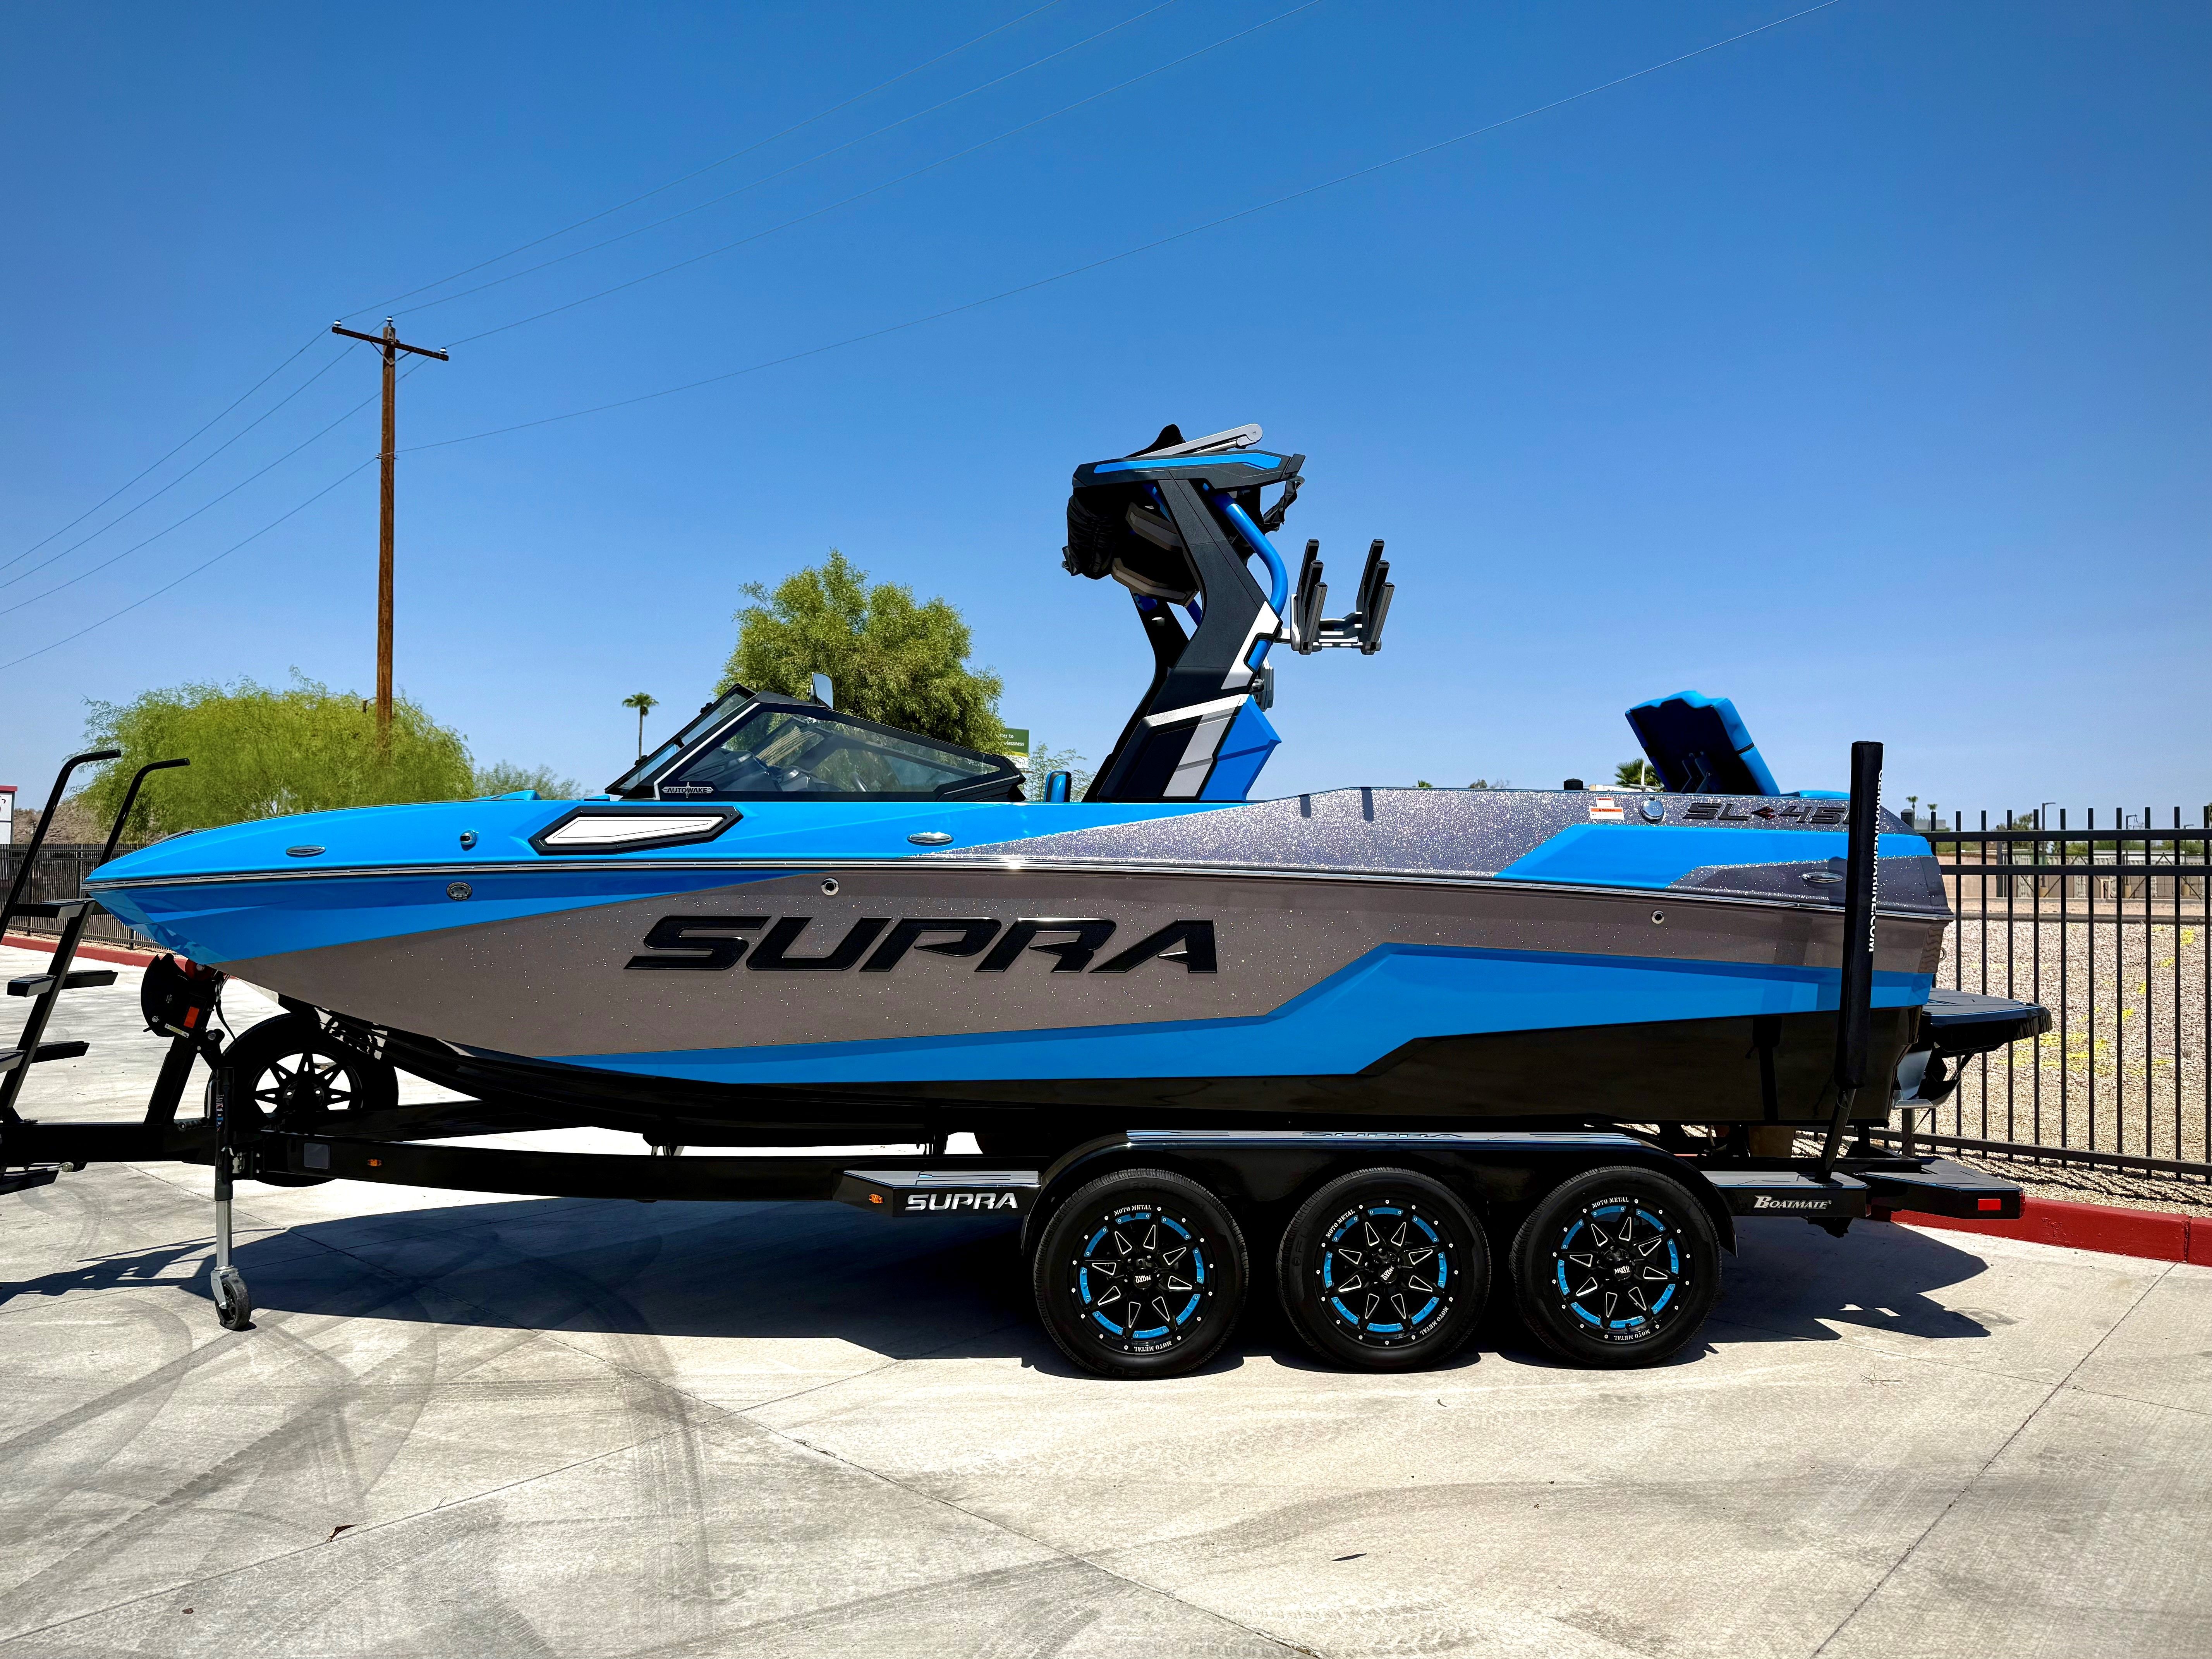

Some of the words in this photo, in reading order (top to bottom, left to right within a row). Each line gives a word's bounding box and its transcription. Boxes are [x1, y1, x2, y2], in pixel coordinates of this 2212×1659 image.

[1682, 802, 1750, 821] SL
[1779, 806, 1850, 825] 45
[623, 915, 1219, 974] SUPRA
[905, 1193, 1018, 1211] SUPRA
[1592, 1199, 1608, 1209] MOTO
[1114, 1206, 1130, 1216] MOTO
[1326, 1223, 1338, 1238] MOTO
[1337, 1209, 1355, 1224] METAL
[1436, 1306, 1449, 1321] MOTO
[1420, 1320, 1437, 1335] METAL
[1635, 1329, 1650, 1338] MOTO
[1156, 1340, 1172, 1350] MOTO
